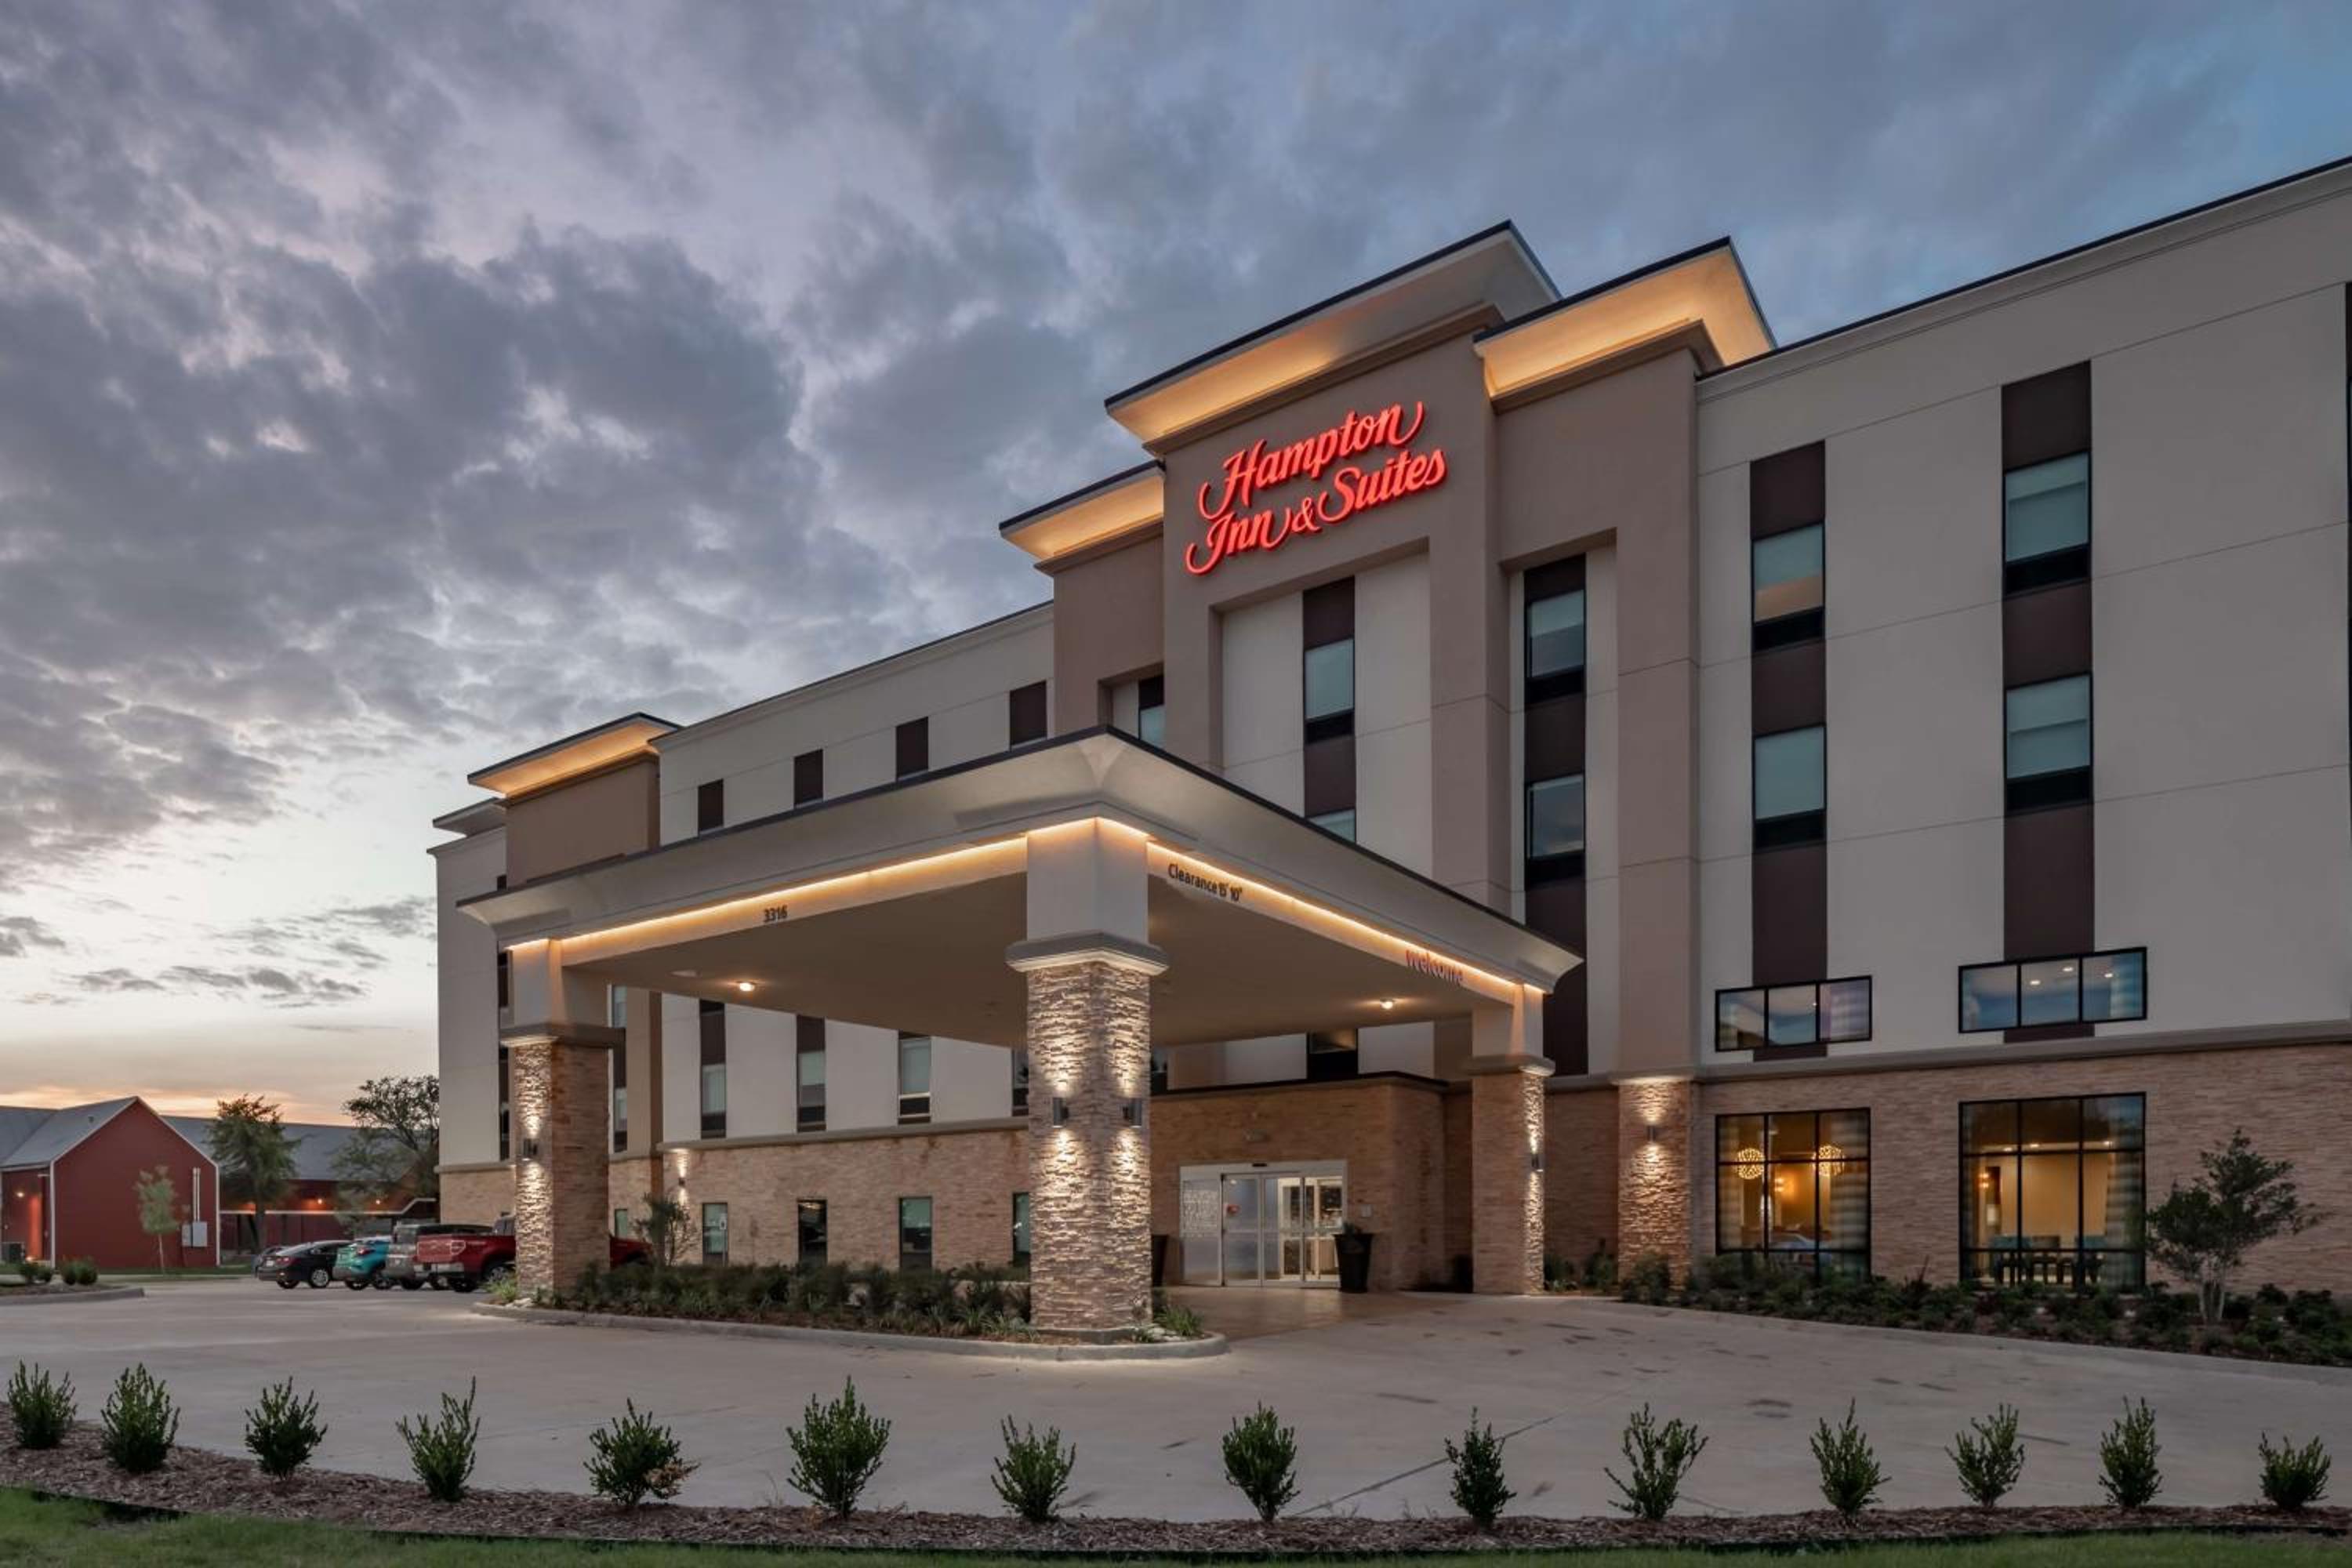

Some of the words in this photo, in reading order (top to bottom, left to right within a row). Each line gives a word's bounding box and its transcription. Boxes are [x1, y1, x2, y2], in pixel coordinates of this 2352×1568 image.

[1199, 401, 1425, 521] Hampton
[1185, 507, 1292, 574] Inn
[1290, 497, 1323, 533] &
[1317, 448, 1447, 523] Suites
[764, 905, 788, 924] 3316
[1168, 863, 1218, 895] Clearance
